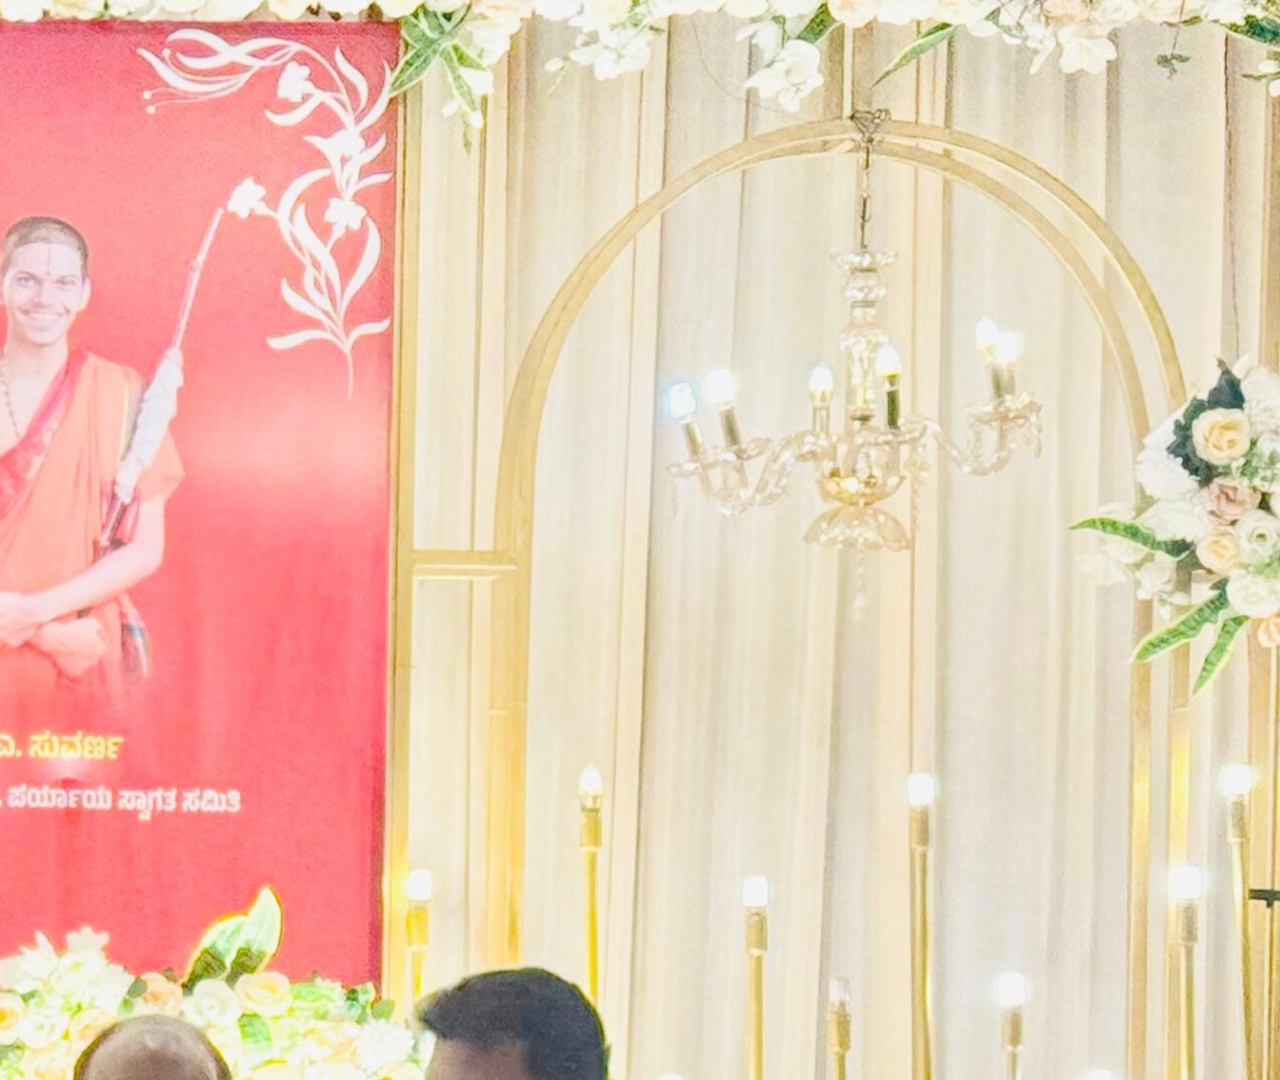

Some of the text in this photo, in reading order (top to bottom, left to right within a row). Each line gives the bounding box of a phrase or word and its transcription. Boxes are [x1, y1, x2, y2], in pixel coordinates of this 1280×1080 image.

[28, 730, 125, 760] ಸುವರ್ಣ
[7, 783, 113, 811] ಪರ್ಯಾಯ
[117, 786, 178, 822] ಸ್ವಾಗತ
[181, 788, 243, 814] ಸಮಿತಿ
